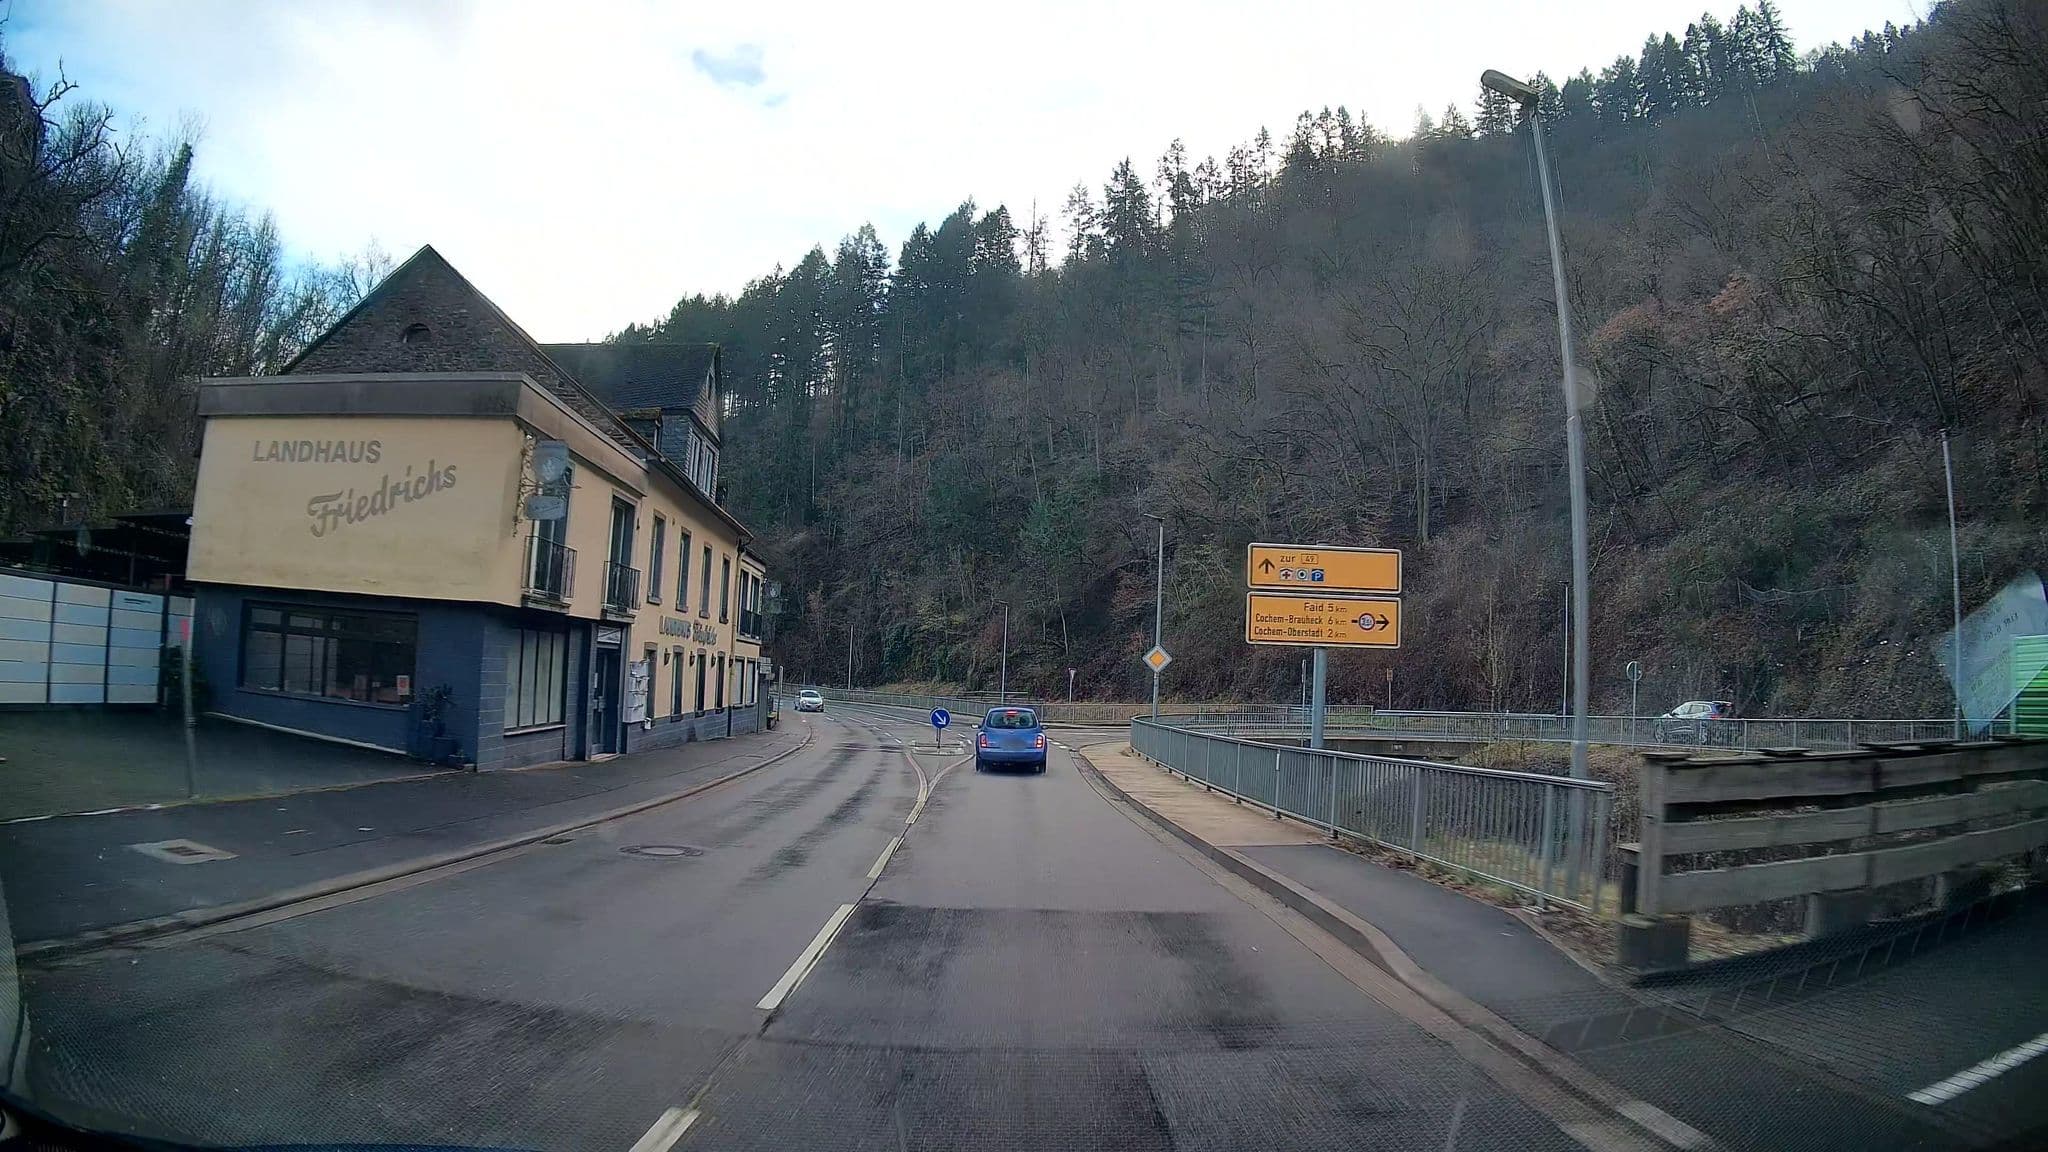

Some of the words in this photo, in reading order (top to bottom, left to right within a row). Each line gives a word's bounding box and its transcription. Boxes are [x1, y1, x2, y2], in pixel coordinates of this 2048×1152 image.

[252, 440, 382, 464] LANDHAUS
[307, 460, 457, 538] Friedrichs
[1280, 555, 1296, 563] zur
[1304, 602, 1324, 612] Faid
[1328, 603, 1334, 612] 5
[1336, 605, 1347, 613] km
[1328, 616, 1333, 625] 6
[1336, 618, 1347, 626] km
[1254, 626, 1323, 638] Cochem-Oberstadt
[1327, 629, 1333, 638] 2
[1335, 630, 1347, 639] km
